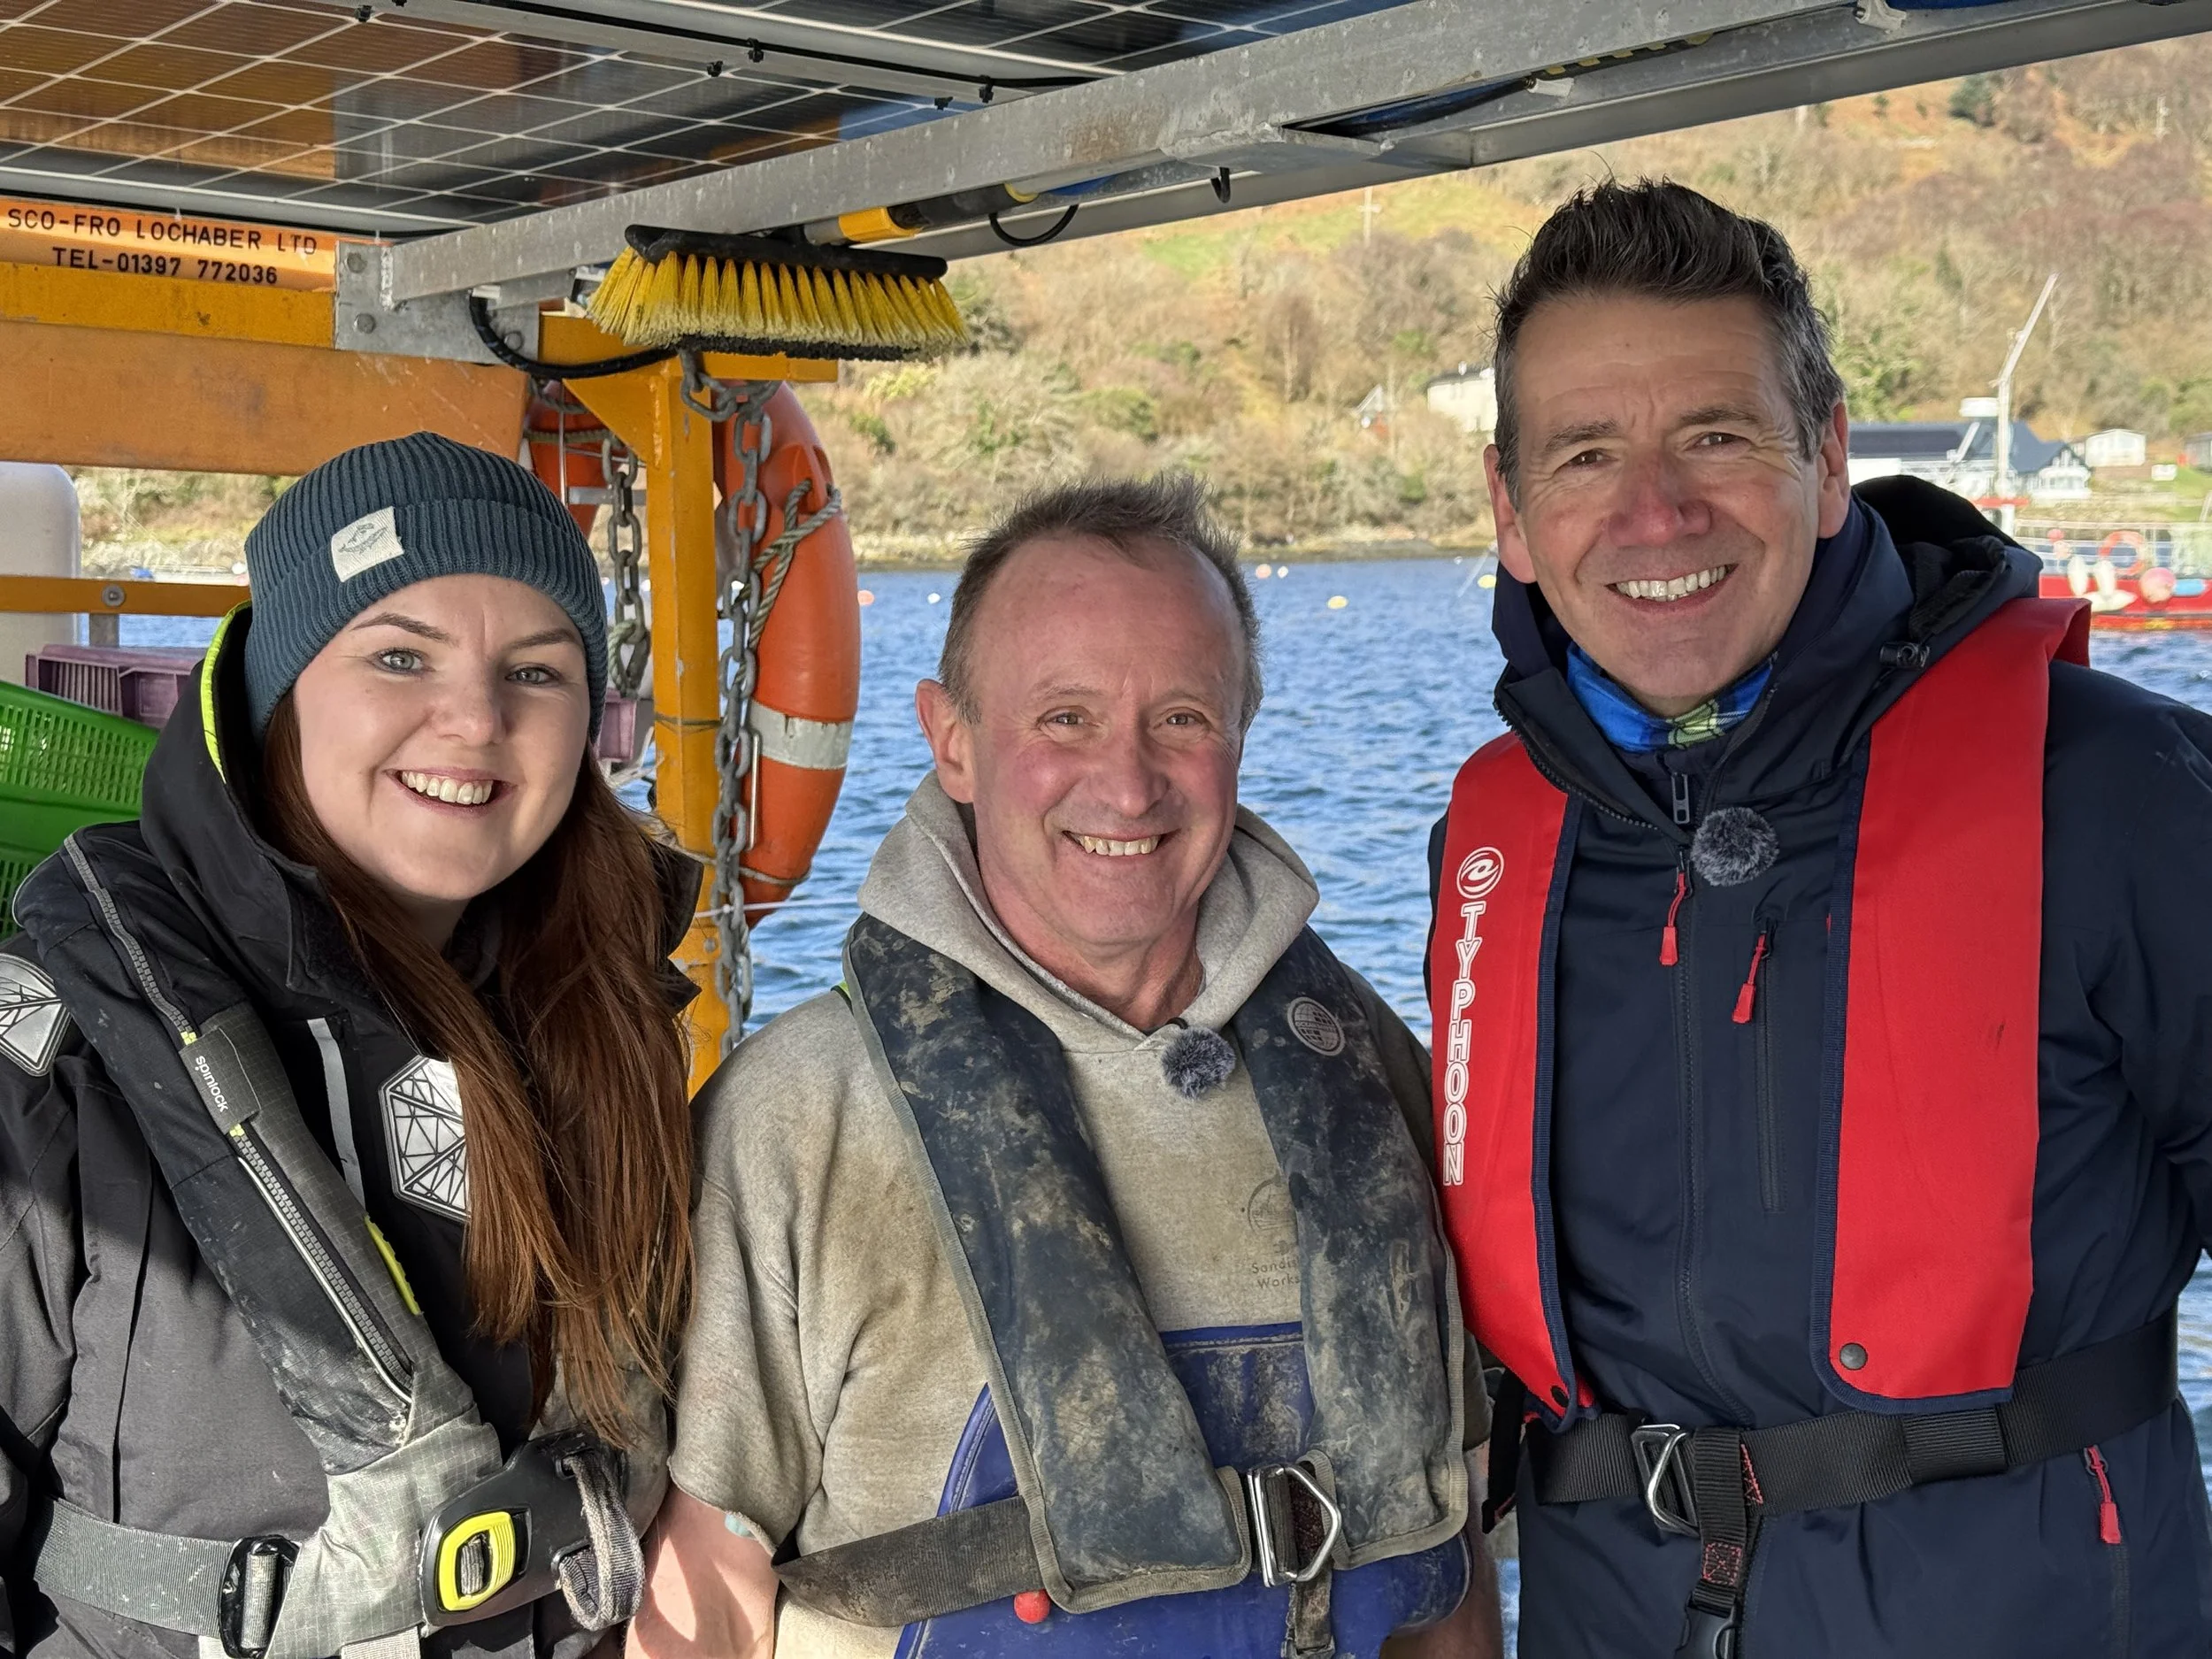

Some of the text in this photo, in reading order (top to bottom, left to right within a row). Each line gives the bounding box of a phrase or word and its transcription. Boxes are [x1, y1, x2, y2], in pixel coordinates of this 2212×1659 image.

[8, 209, 318, 255] SCO-FRO LOCHABER LTD
[52, 246, 278, 285] TEL-01397 772036
[1443, 900, 1486, 1187] TYPHOON
[195, 1056, 228, 1112] spinlock
